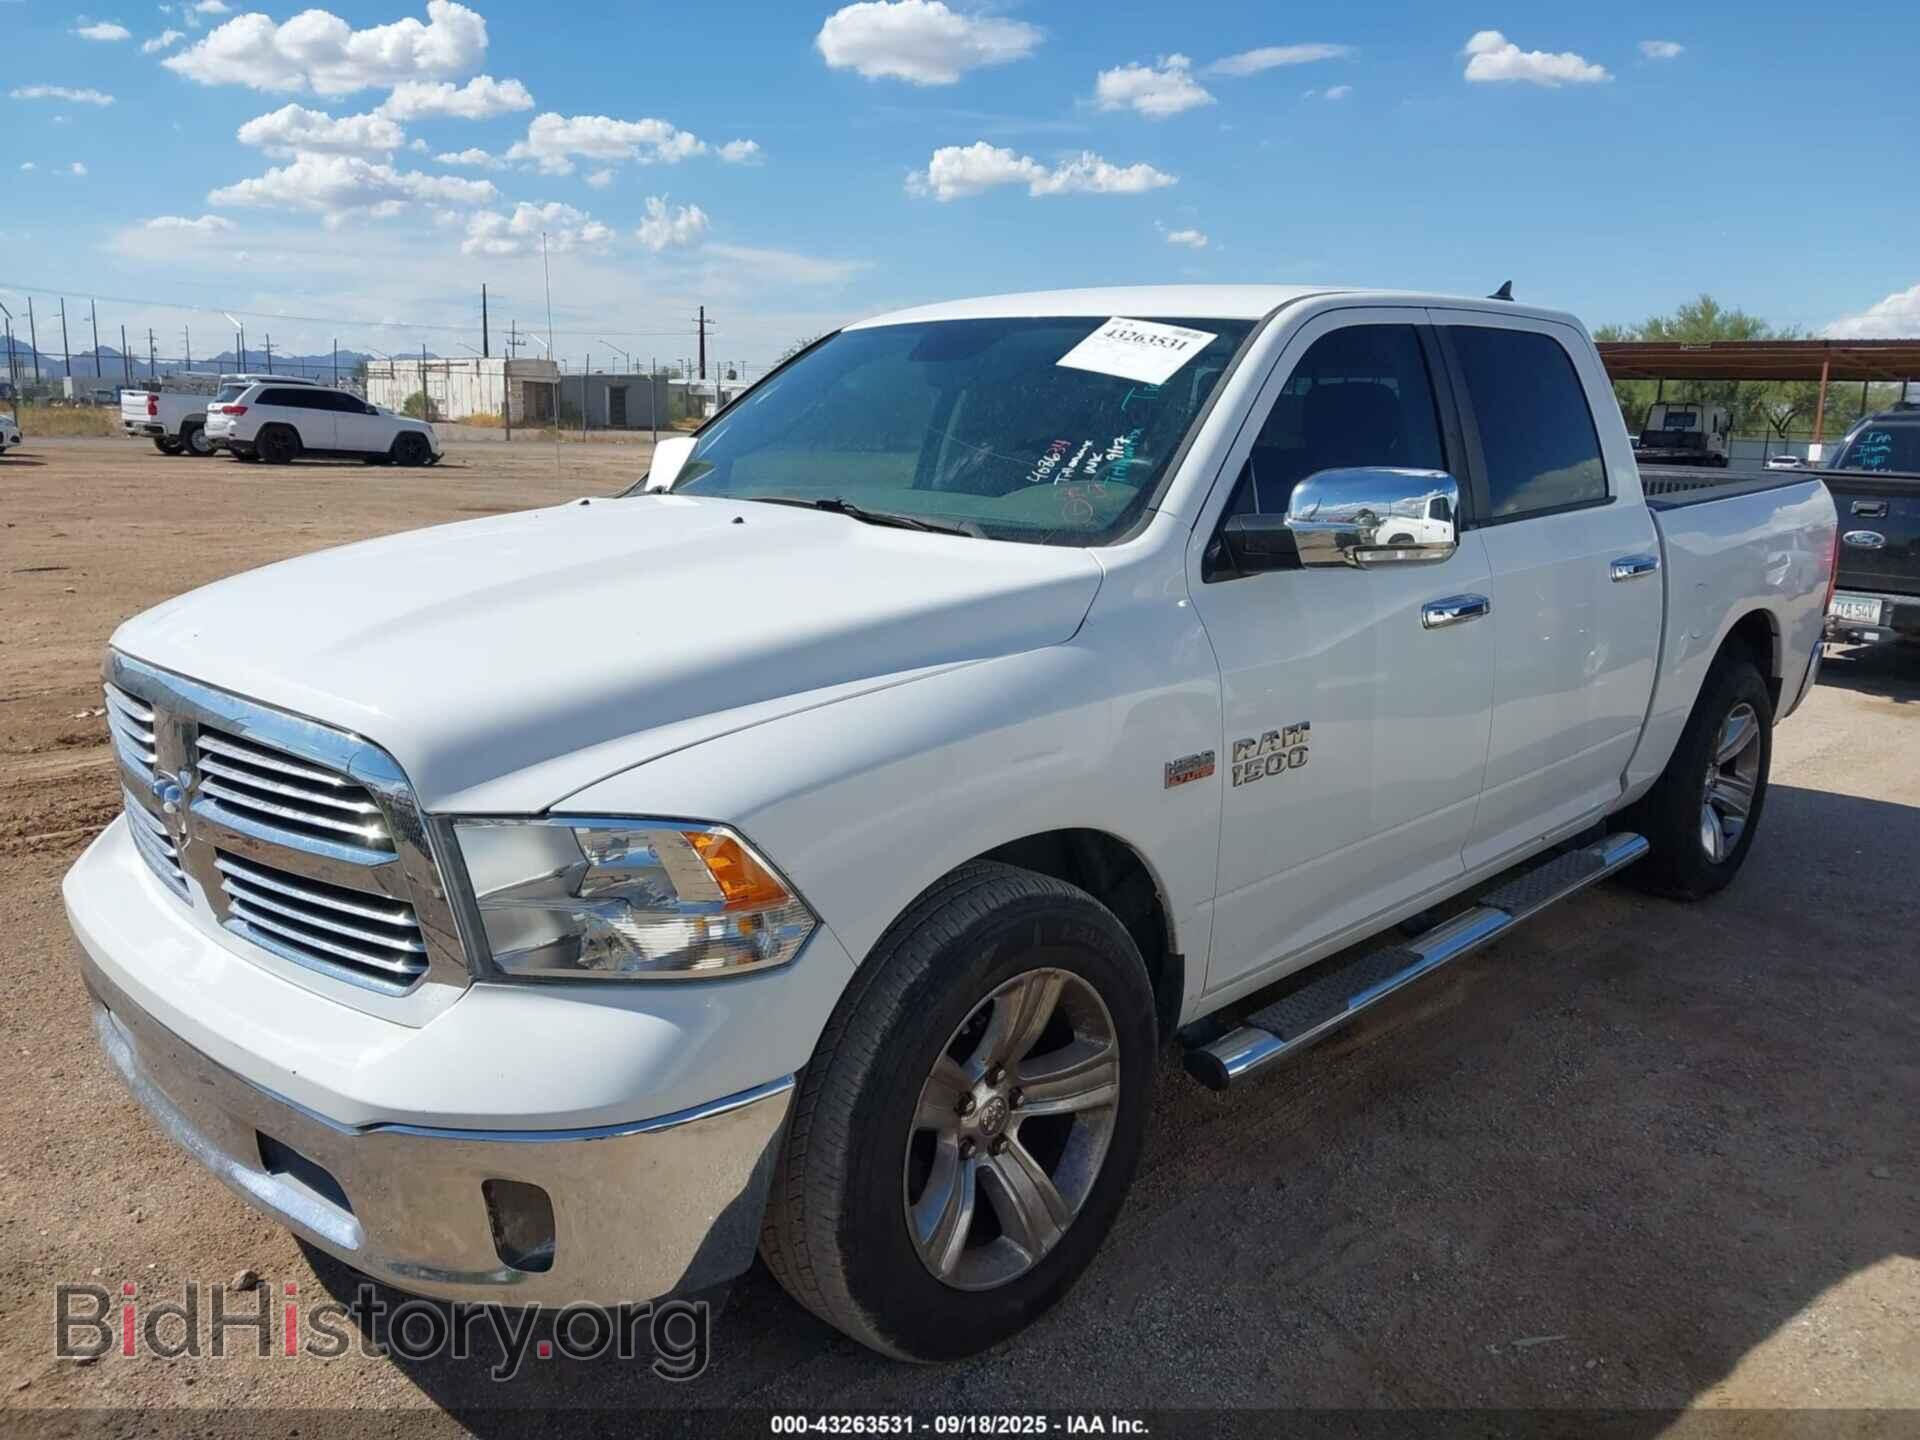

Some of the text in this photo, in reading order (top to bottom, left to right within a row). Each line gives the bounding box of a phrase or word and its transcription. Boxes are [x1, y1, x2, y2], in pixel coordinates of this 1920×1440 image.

[1104, 328, 1189, 351] 43263531
[1232, 720, 1311, 763] RAM
[1232, 745, 1309, 788] 1500
